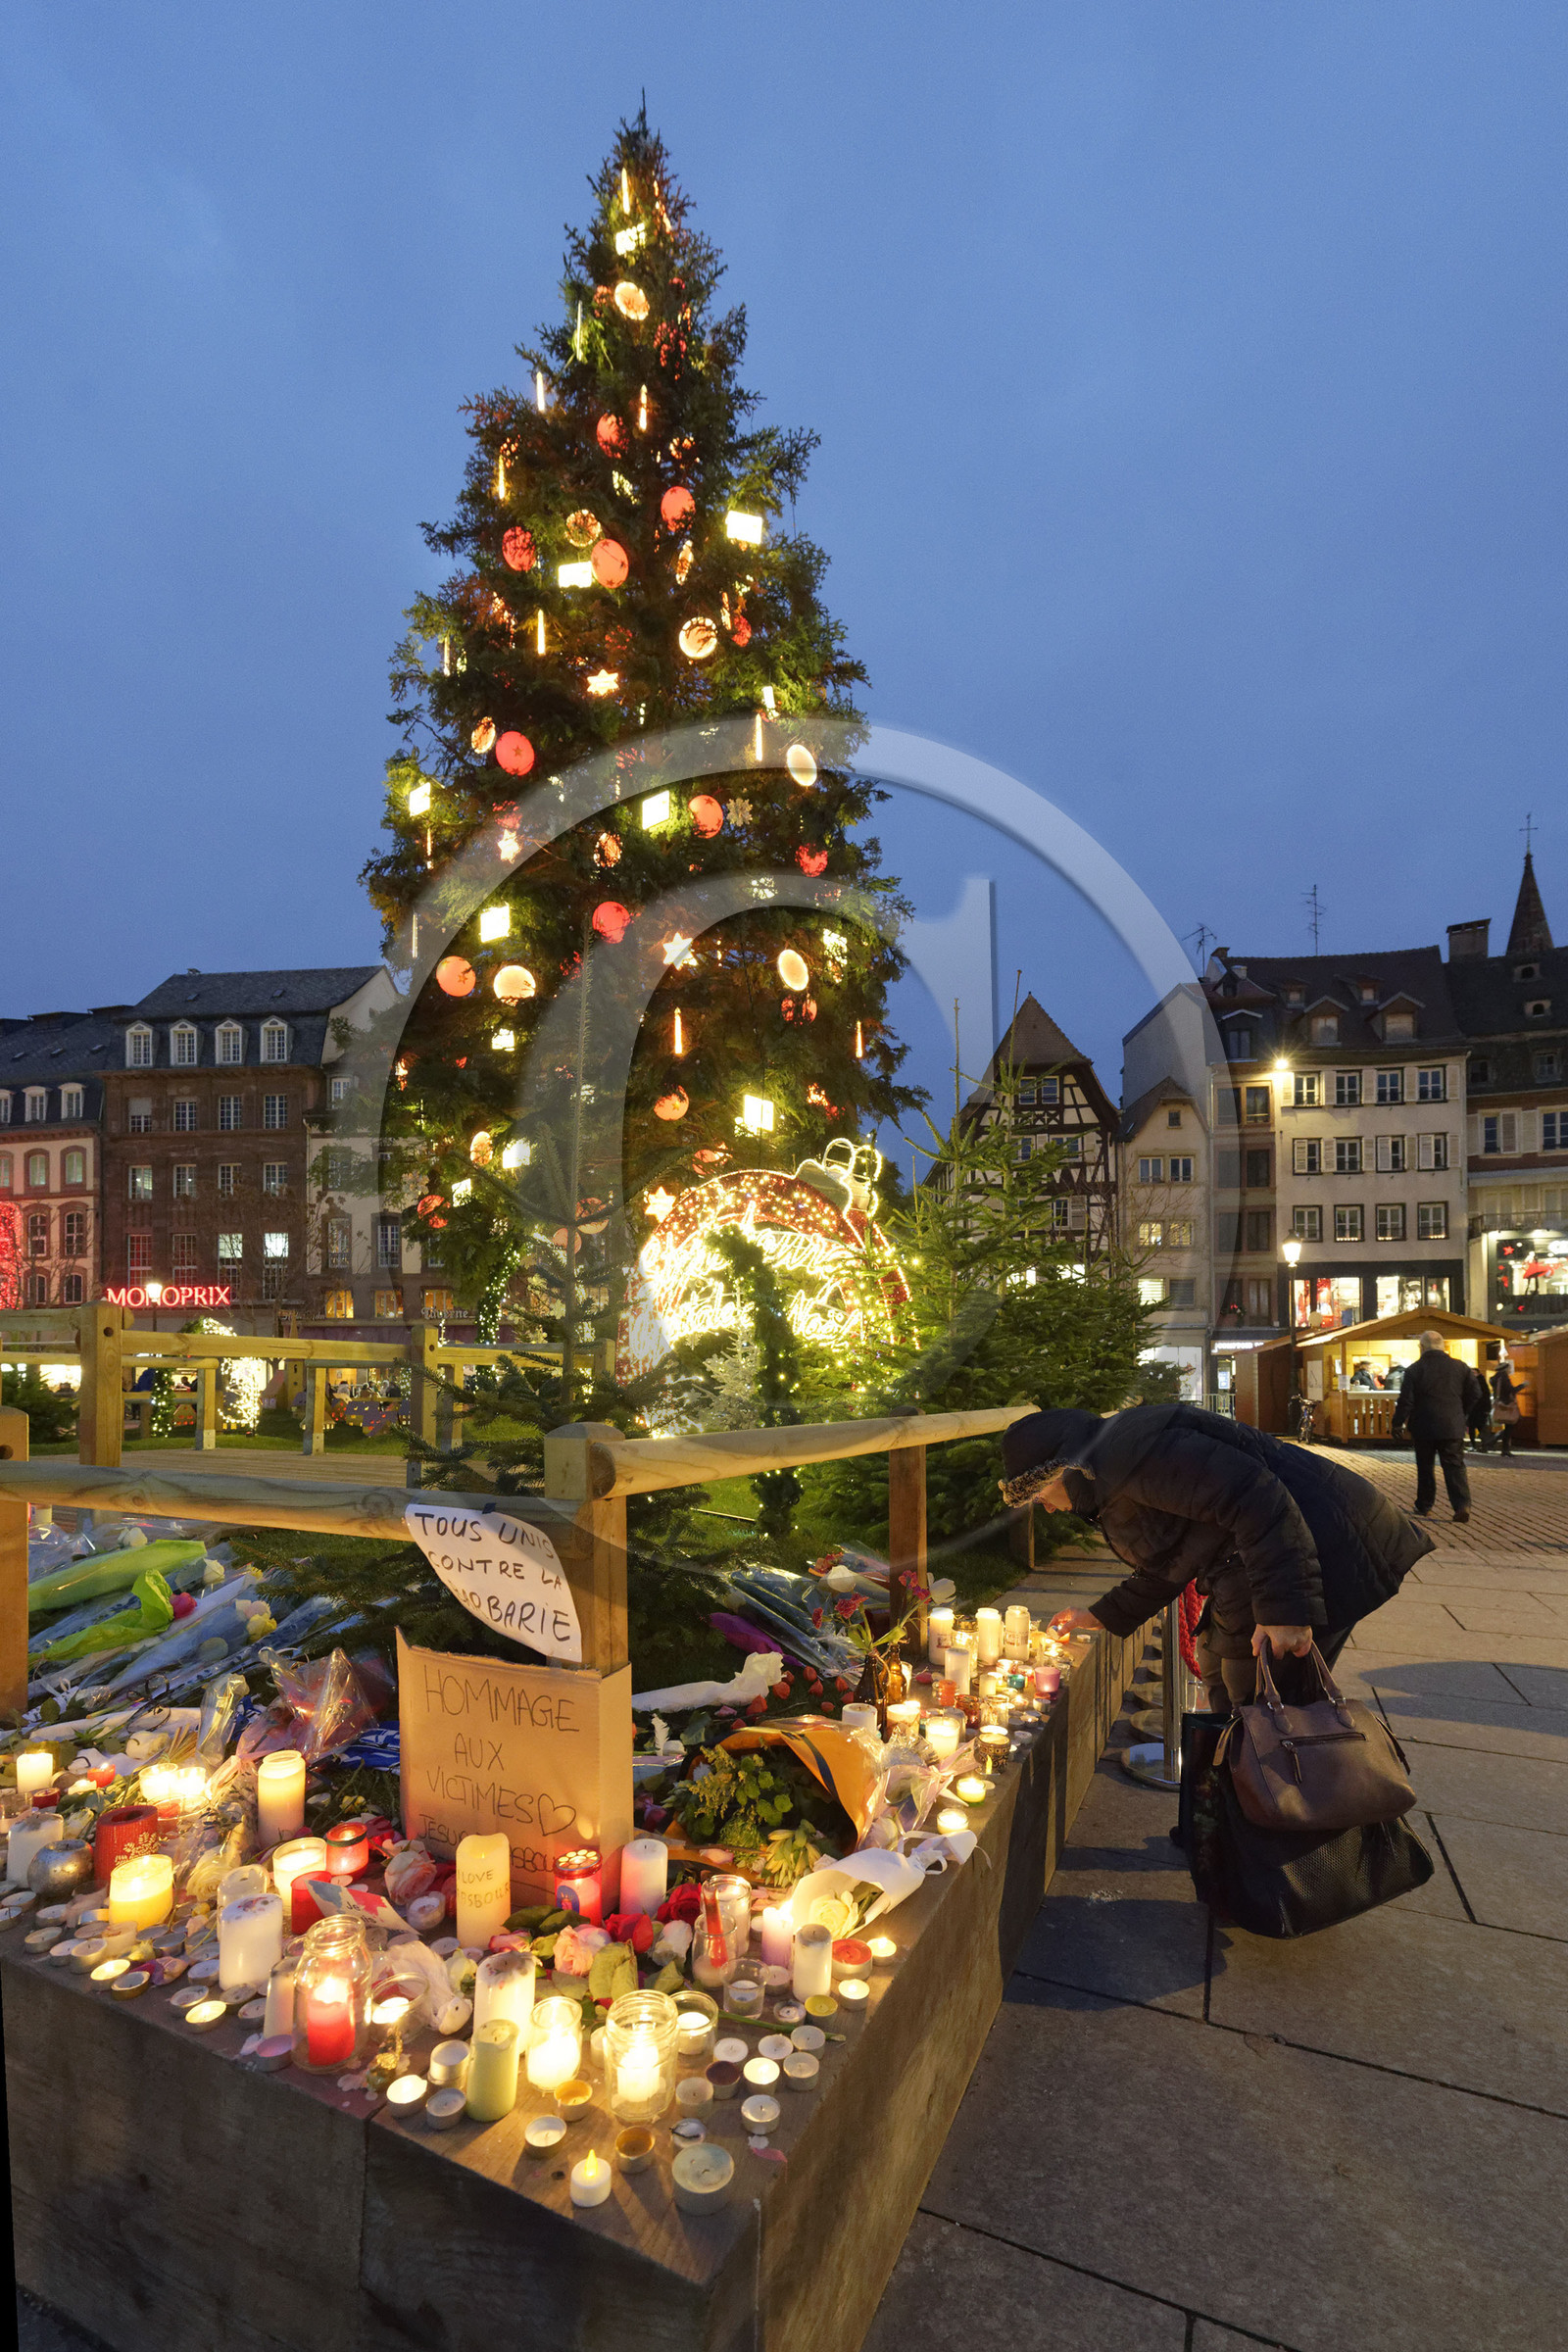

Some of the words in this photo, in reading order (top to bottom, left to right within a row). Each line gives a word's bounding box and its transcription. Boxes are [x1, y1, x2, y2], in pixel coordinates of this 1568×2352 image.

[415, 1512, 482, 1543] TOUS
[498, 1522, 555, 1559] UNIS
[428, 1550, 525, 1580] CONTRE
[541, 1568, 563, 1591] LA
[424, 1664, 580, 1732] HOMMAGE
[454, 1733, 504, 1771] AUX
[426, 1766, 534, 1824] VICTIMES
[462, 1869, 494, 1884] LOVE
[346, 1901, 361, 1912] Je
